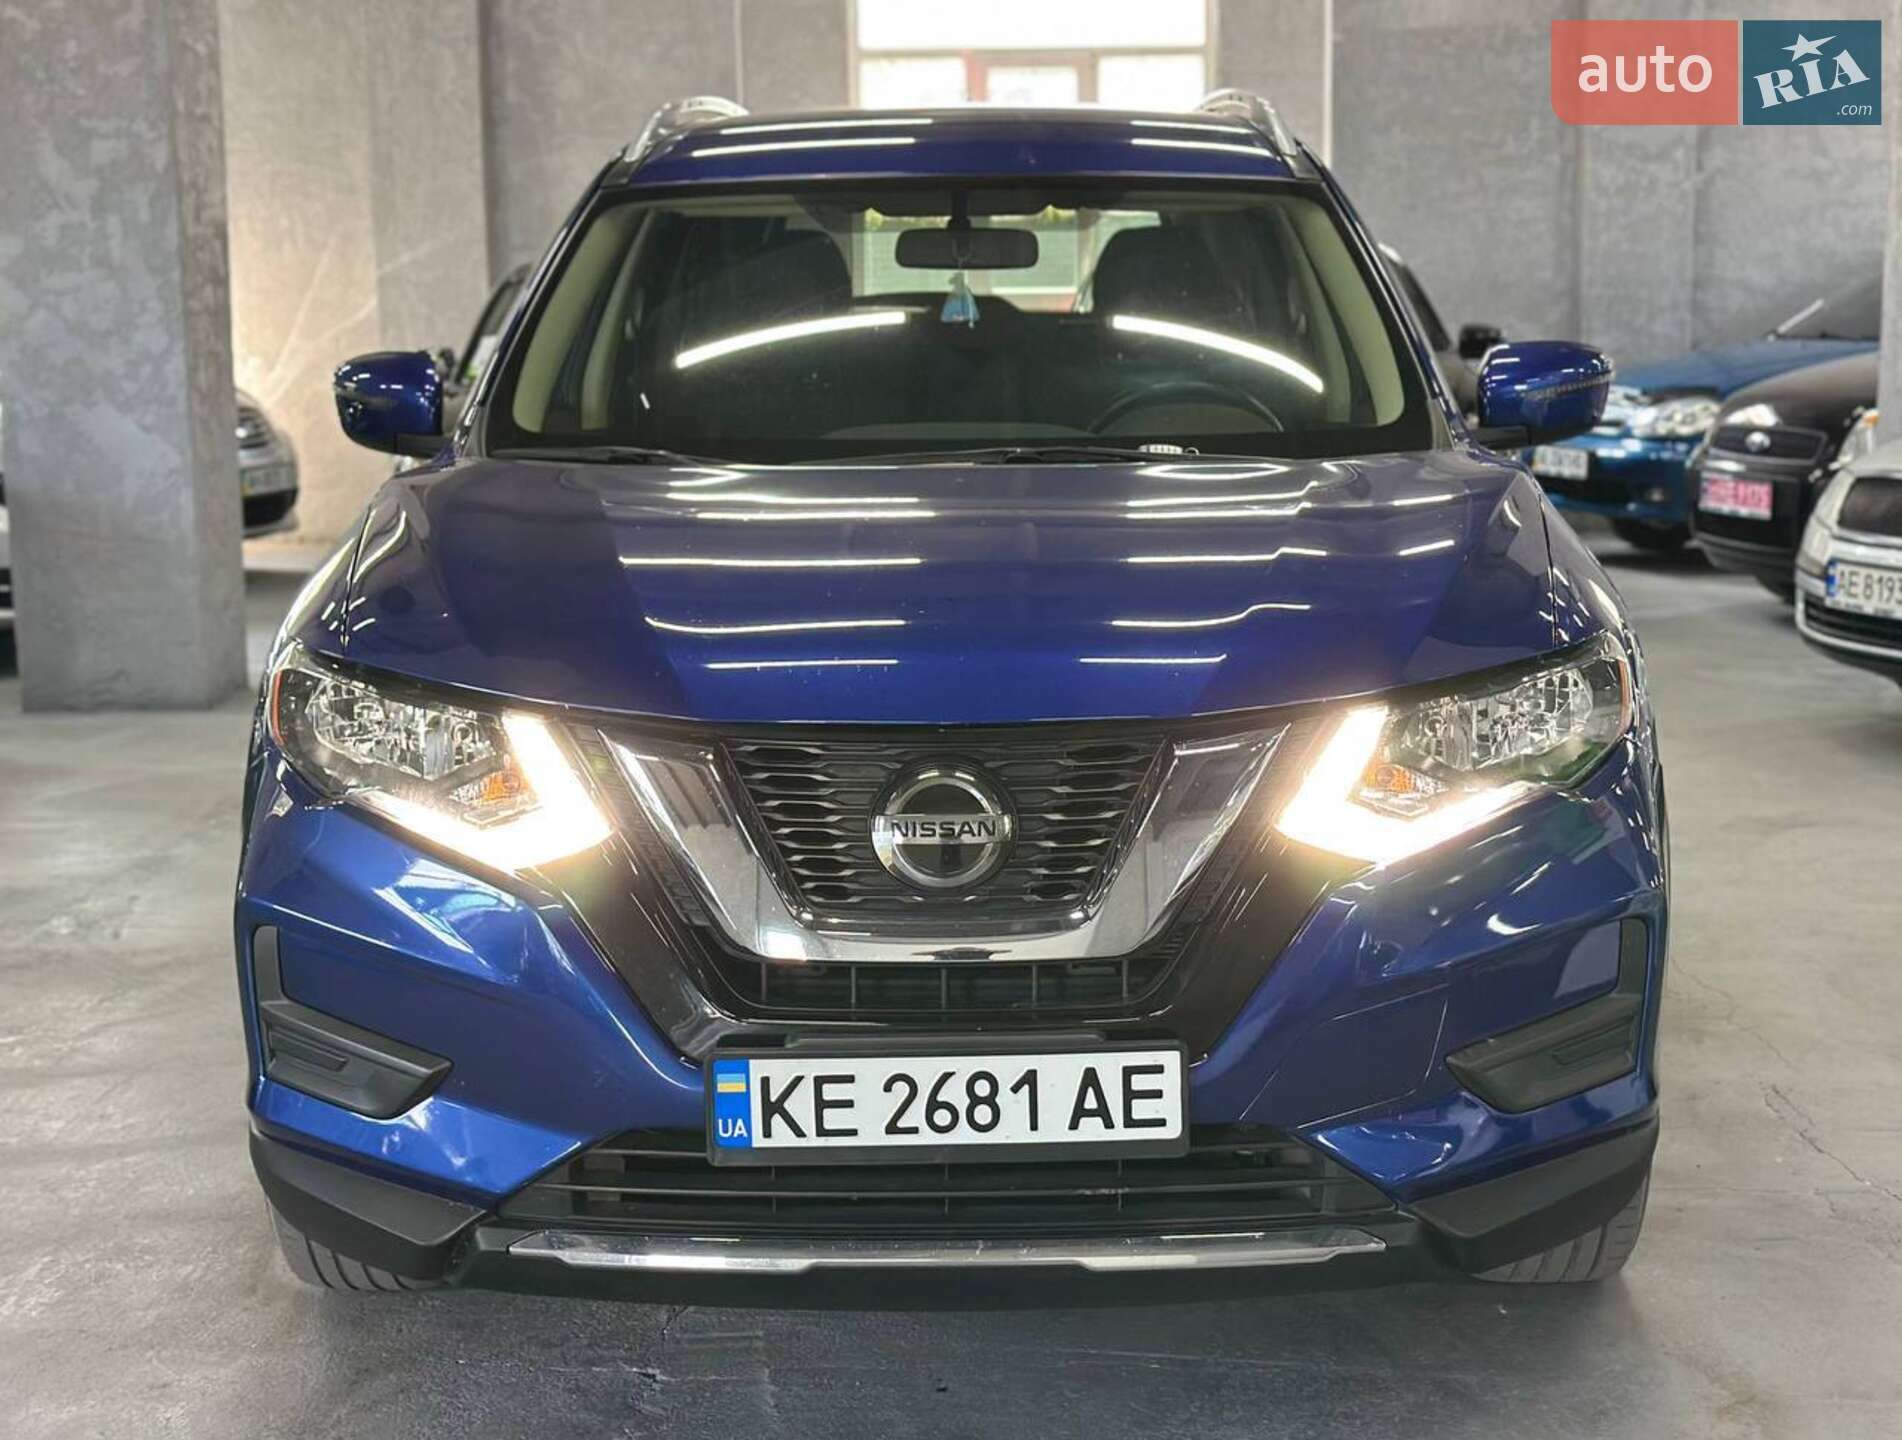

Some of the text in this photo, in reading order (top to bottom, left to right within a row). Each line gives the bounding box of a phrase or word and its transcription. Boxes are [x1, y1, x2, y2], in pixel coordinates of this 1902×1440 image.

[890, 820, 997, 839] NISSAN
[760, 1064, 1168, 1138] KE 2681 AE
[718, 1117, 748, 1138] UA
